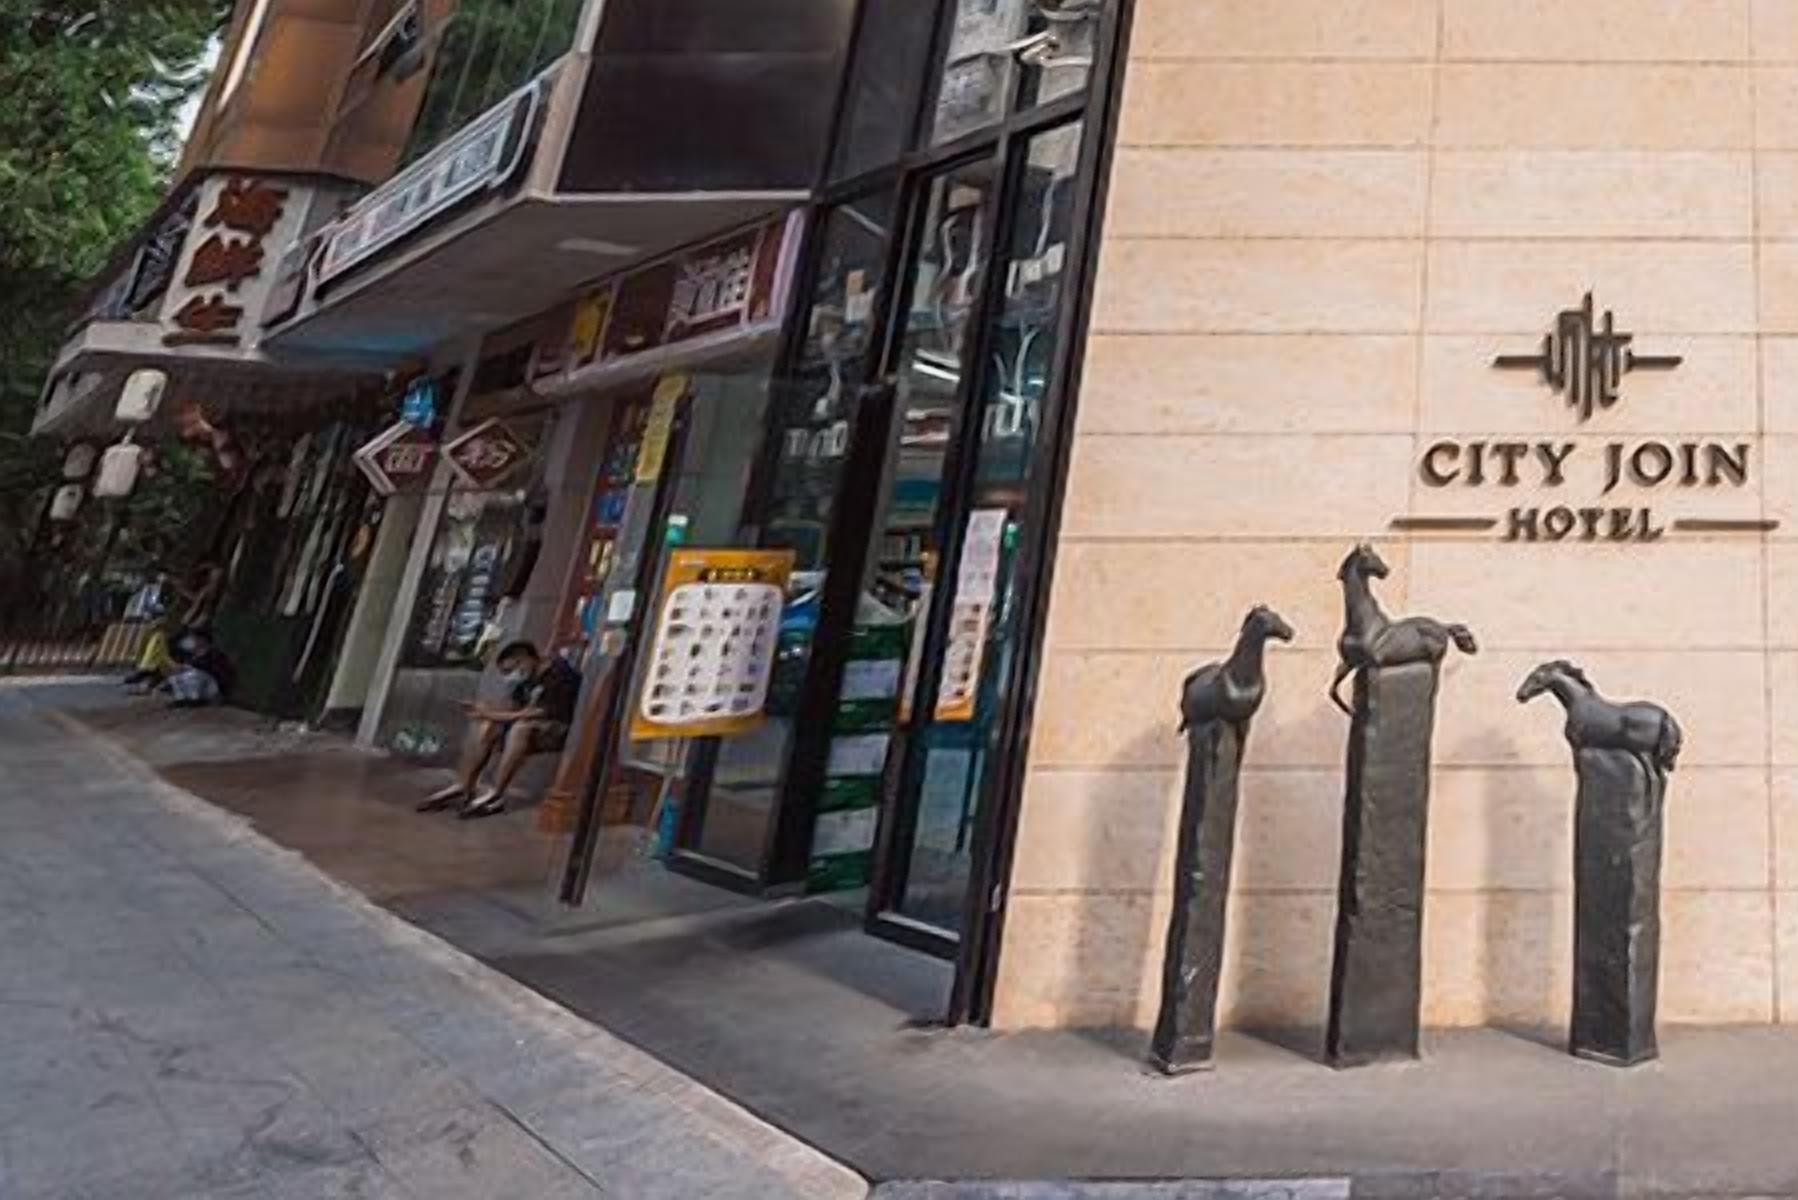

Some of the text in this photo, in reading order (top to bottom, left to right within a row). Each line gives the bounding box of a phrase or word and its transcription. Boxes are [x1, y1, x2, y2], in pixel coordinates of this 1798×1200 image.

[1420, 441, 1750, 494] CITY JOIN
[1502, 506, 1665, 543] HOTEL
